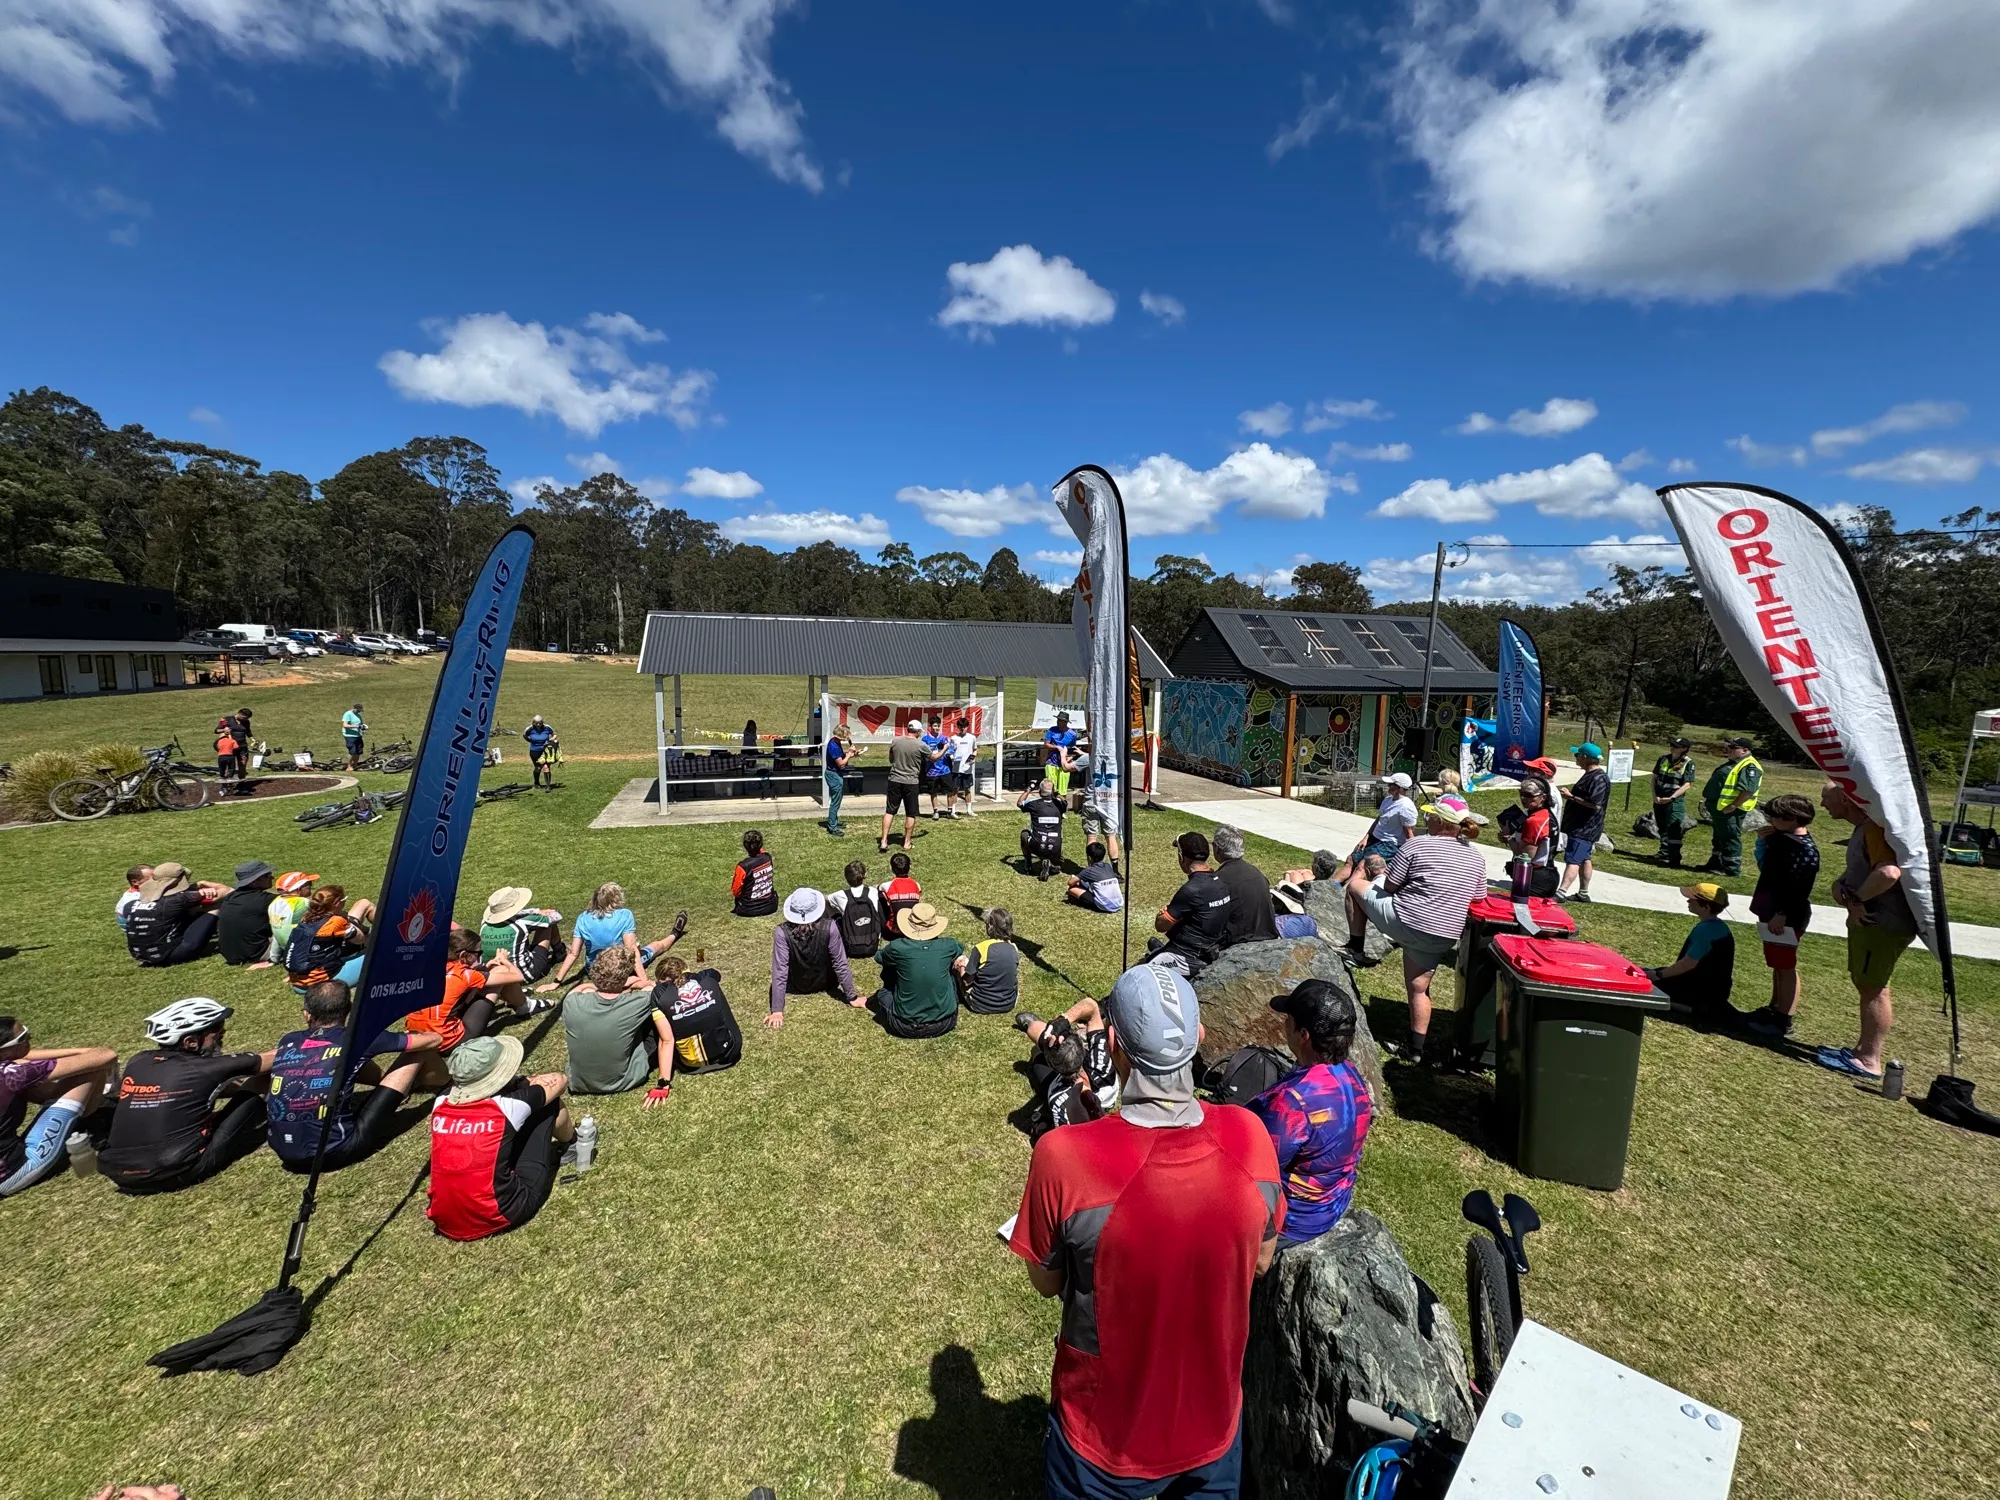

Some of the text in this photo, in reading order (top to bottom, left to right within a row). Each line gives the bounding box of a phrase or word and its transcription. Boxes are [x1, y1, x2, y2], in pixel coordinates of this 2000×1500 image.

[1501, 671, 1512, 702] NSW
[1512, 639, 1525, 736] ORIENTEERING
[836, 702, 984, 739] I MTBO
[36, 1117, 63, 1159] 2XU
